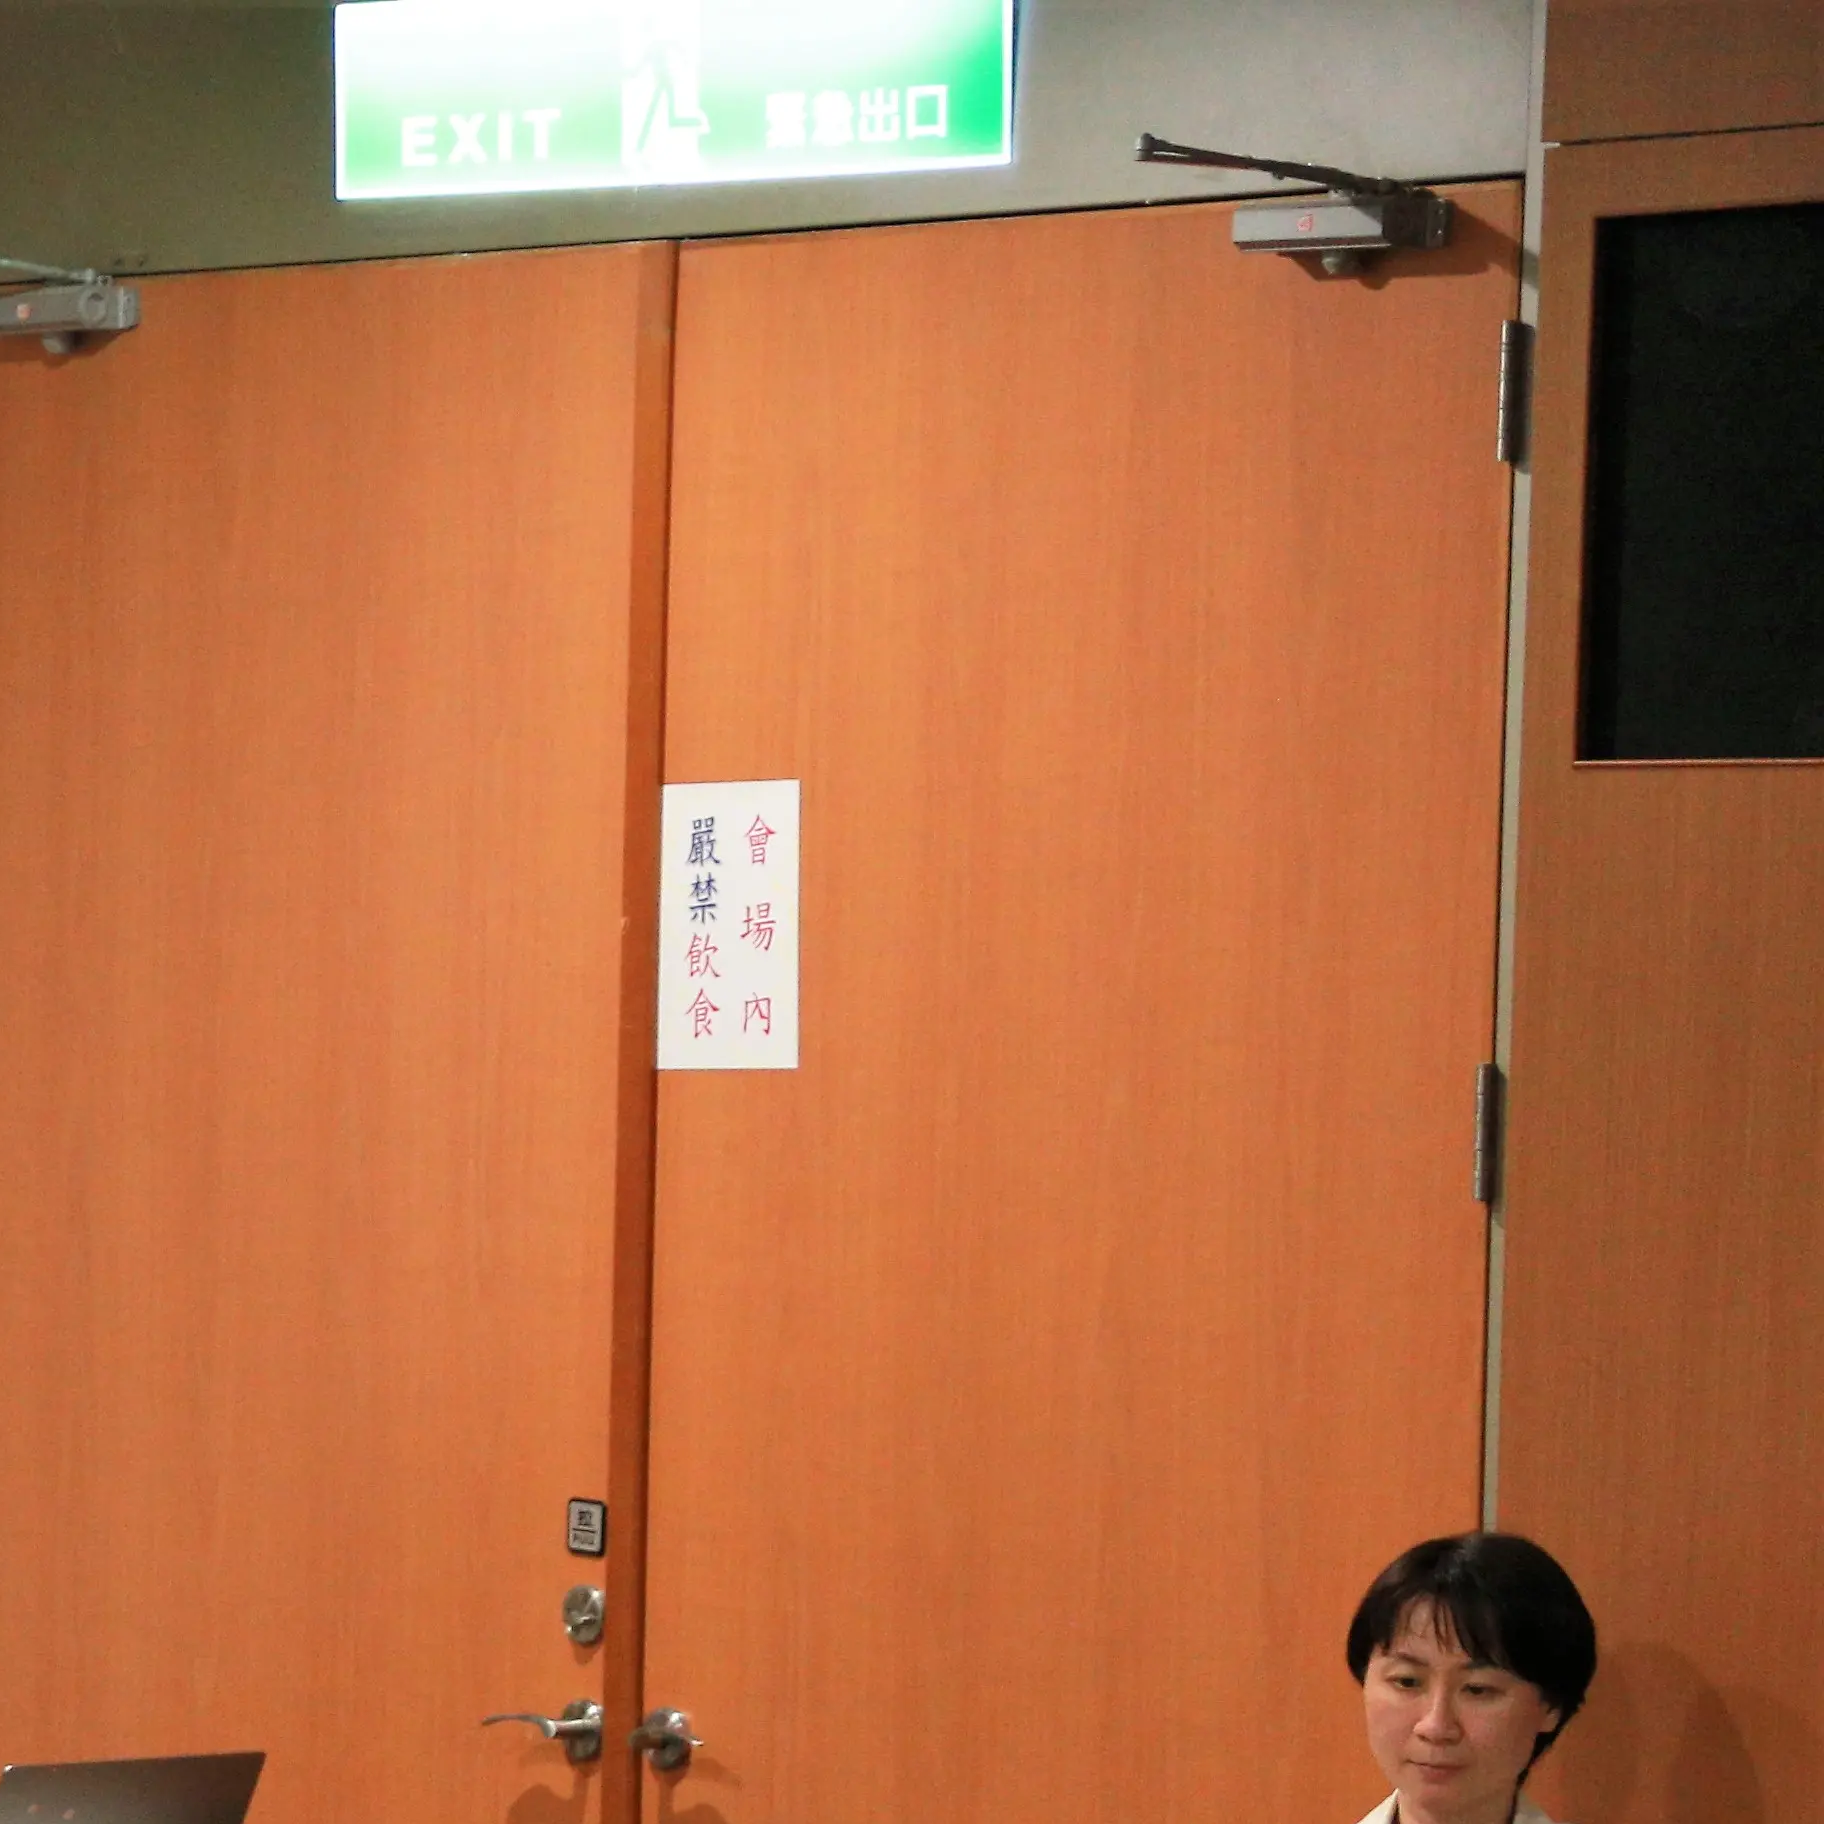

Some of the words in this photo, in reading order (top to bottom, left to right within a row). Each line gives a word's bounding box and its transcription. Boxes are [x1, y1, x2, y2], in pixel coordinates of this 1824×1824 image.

[400, 108, 562, 168] EXIT
[684, 815, 721, 1039] 嚴禁飲食
[740, 813, 776, 1036] 會場內
